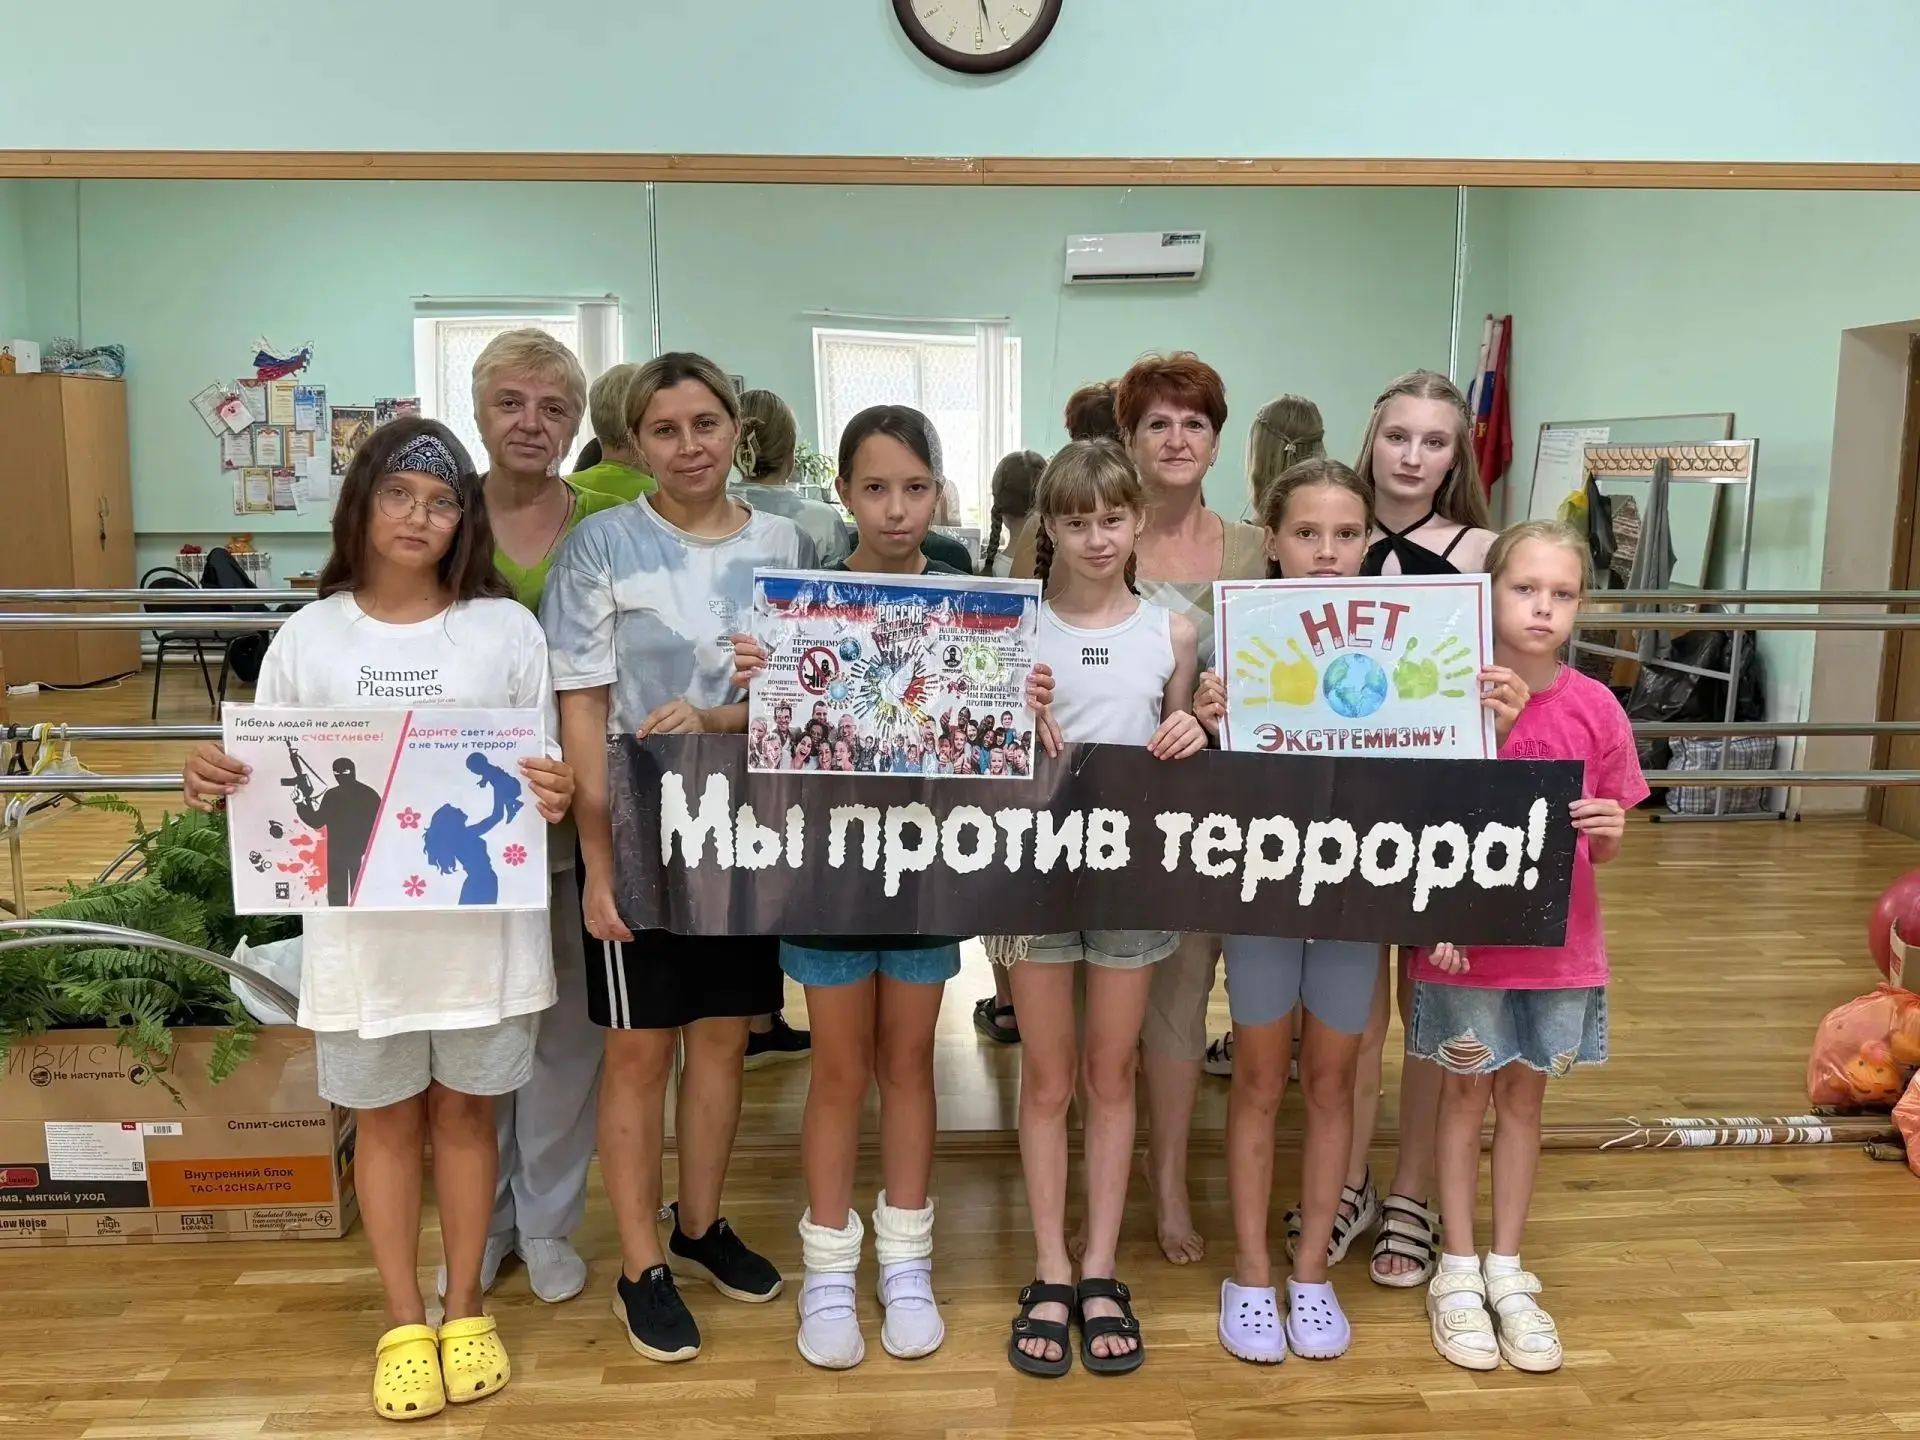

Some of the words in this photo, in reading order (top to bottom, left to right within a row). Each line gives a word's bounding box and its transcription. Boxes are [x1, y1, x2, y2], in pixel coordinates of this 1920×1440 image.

[878, 604, 923, 623] РОССИЯ
[1299, 600, 1410, 656] НЕТ
[792, 638, 839, 647] ТЕРРОРИЗМУ
[360, 665, 439, 681] Summer
[356, 680, 443, 697] Pleasures
[235, 717, 275, 728] Гибель
[277, 719, 313, 728] людей
[315, 720, 329, 728] не
[330, 720, 371, 728] делает
[236, 734, 264, 744] нашу
[267, 734, 299, 742] жизнь
[301, 732, 384, 742] счастливее!
[407, 727, 458, 738] Дарите
[460, 729, 485, 737] свет
[496, 727, 536, 738] добро,
[419, 741, 431, 749] не
[434, 741, 459, 750] тьму
[471, 741, 517, 751] террор!
[660, 770, 804, 871] Мы
[827, 801, 1131, 898] против
[1154, 797, 1548, 912] террора!
[53, 1071, 68, 1080] Не
[71, 1071, 126, 1081] наступать
[227, 1118, 326, 1130] Сплит-система
[184, 1168, 261, 1181] Внутренний
[263, 1167, 294, 1178] блок
[26, 1191, 72, 1202] мягкий
[74, 1193, 106, 1204] уход
[97, 1218, 120, 1230] High
